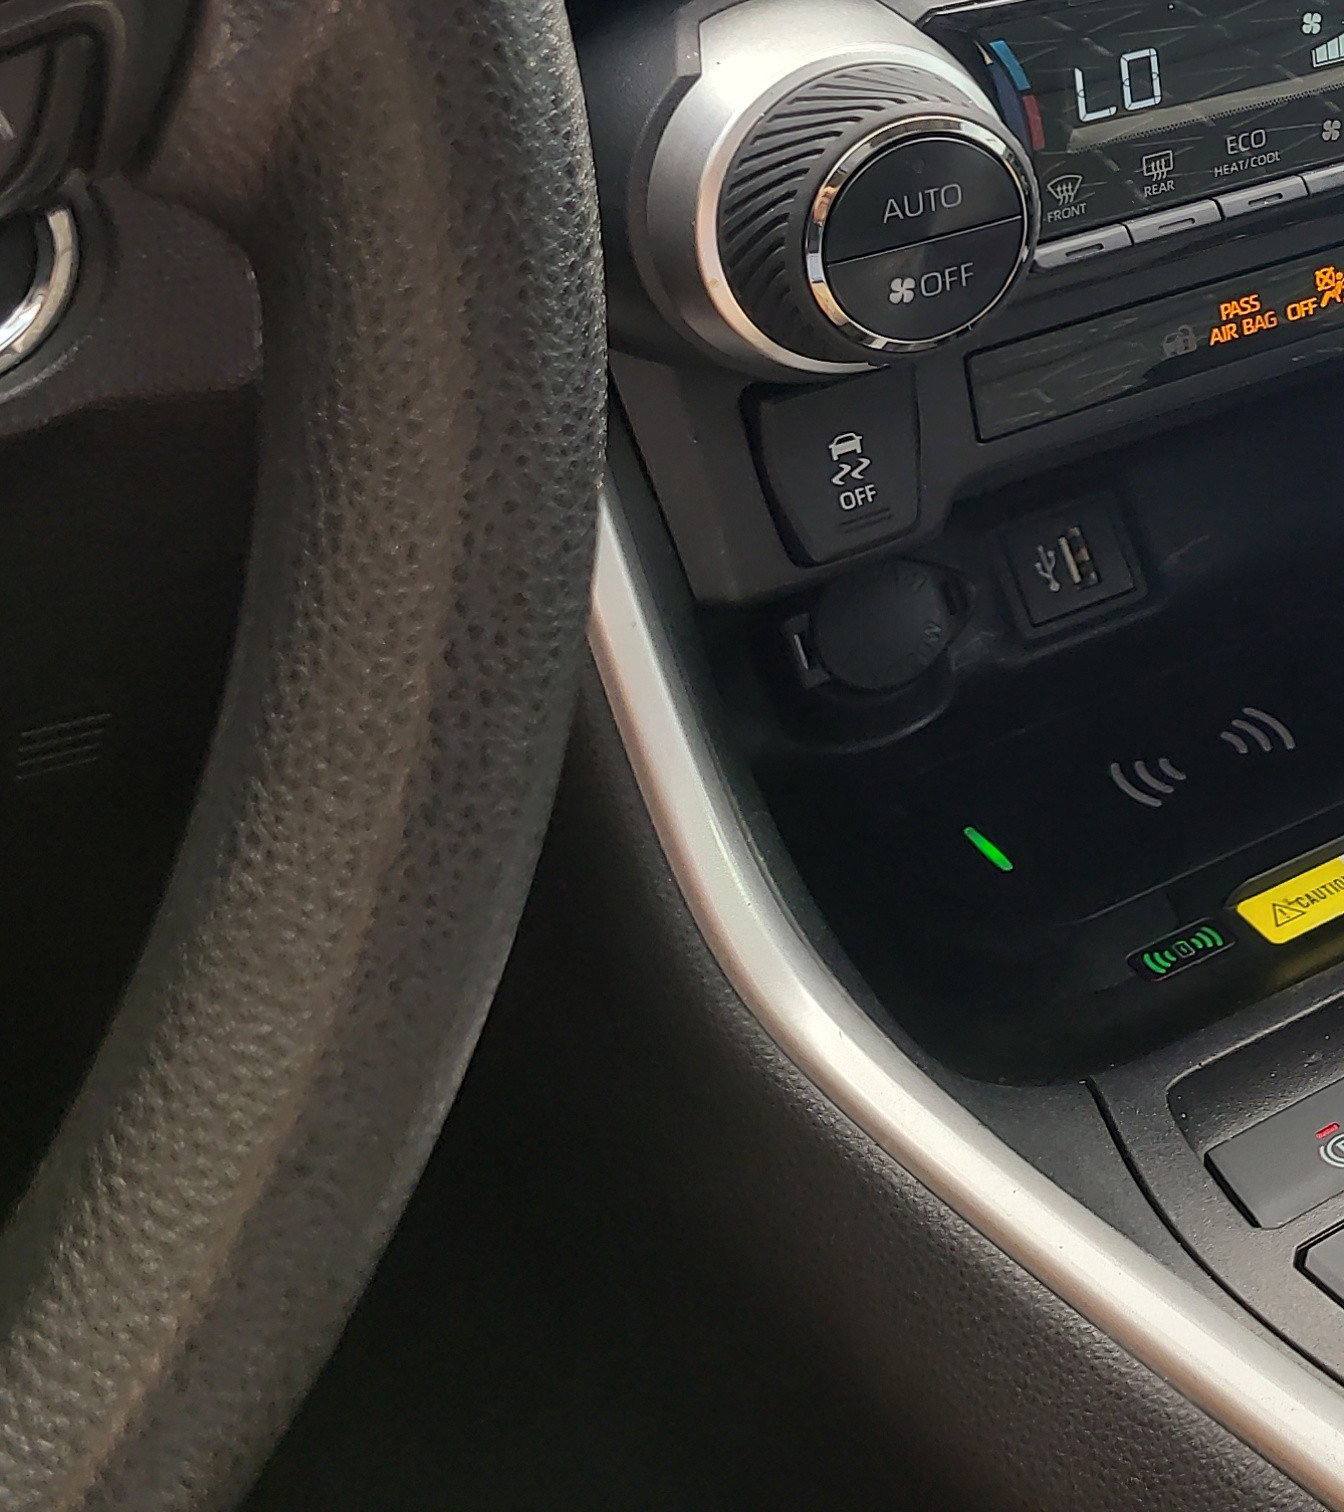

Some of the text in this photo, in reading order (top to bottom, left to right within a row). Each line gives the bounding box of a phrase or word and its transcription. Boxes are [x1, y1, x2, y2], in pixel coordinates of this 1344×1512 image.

[1074, 47, 1163, 122] LO
[1226, 128, 1267, 155] ECO
[1213, 150, 1282, 178] HEAT/COOL
[1143, 179, 1175, 198] REAR
[882, 182, 963, 225] AUTO
[1046, 202, 1087, 224] FRONT
[920, 262, 975, 299] OFF
[1209, 296, 1319, 346] AIR BAG OFF
[1220, 294, 1261, 321] PASS
[839, 484, 878, 511] OFF
